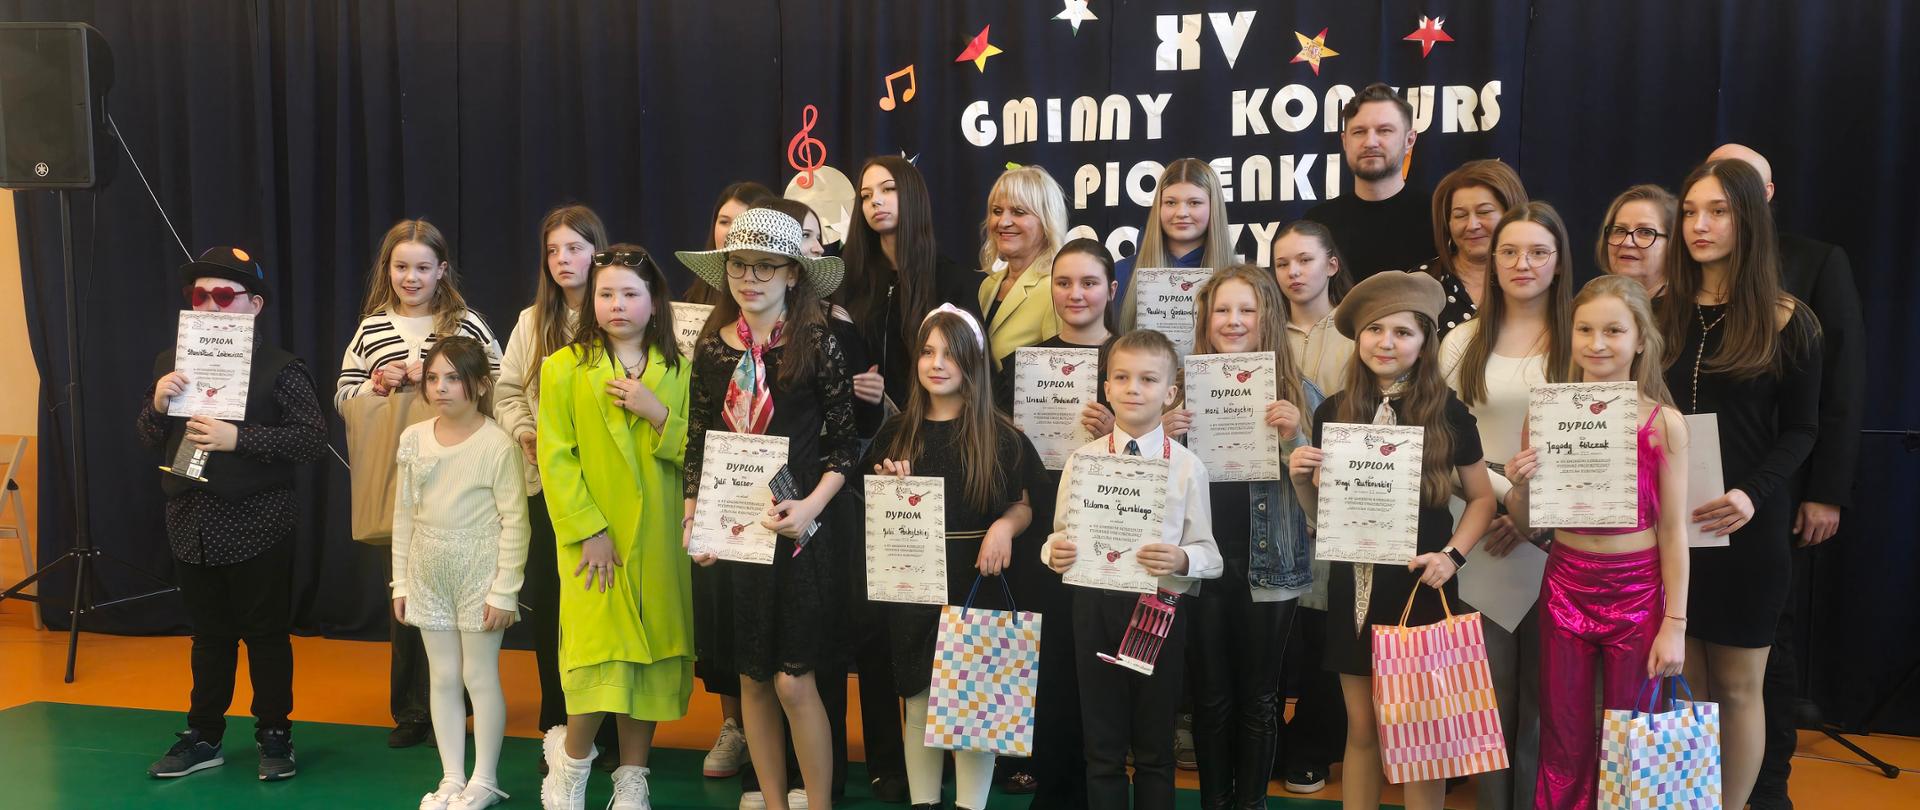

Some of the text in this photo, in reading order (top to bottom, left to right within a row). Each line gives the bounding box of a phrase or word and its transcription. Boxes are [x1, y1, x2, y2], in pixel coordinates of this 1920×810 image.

[1156, 10, 1258, 71] XV
[960, 80, 1502, 146] GMINNY KONURS
[1074, 153, 1341, 209] PIOENKI
[1159, 295, 1193, 303] DYPLOM
[682, 329, 700, 337] DYPL
[200, 337, 234, 345] DYPLOM
[1037, 380, 1075, 389] DYPLOM
[1210, 388, 1252, 399] DYPLOM
[1558, 421, 1608, 432] DYPLOM
[726, 463, 764, 473] DYPLOM
[1349, 460, 1395, 470] DYPLOM
[1097, 485, 1141, 496] DYPLOM
[885, 510, 922, 520] DYPLOM
